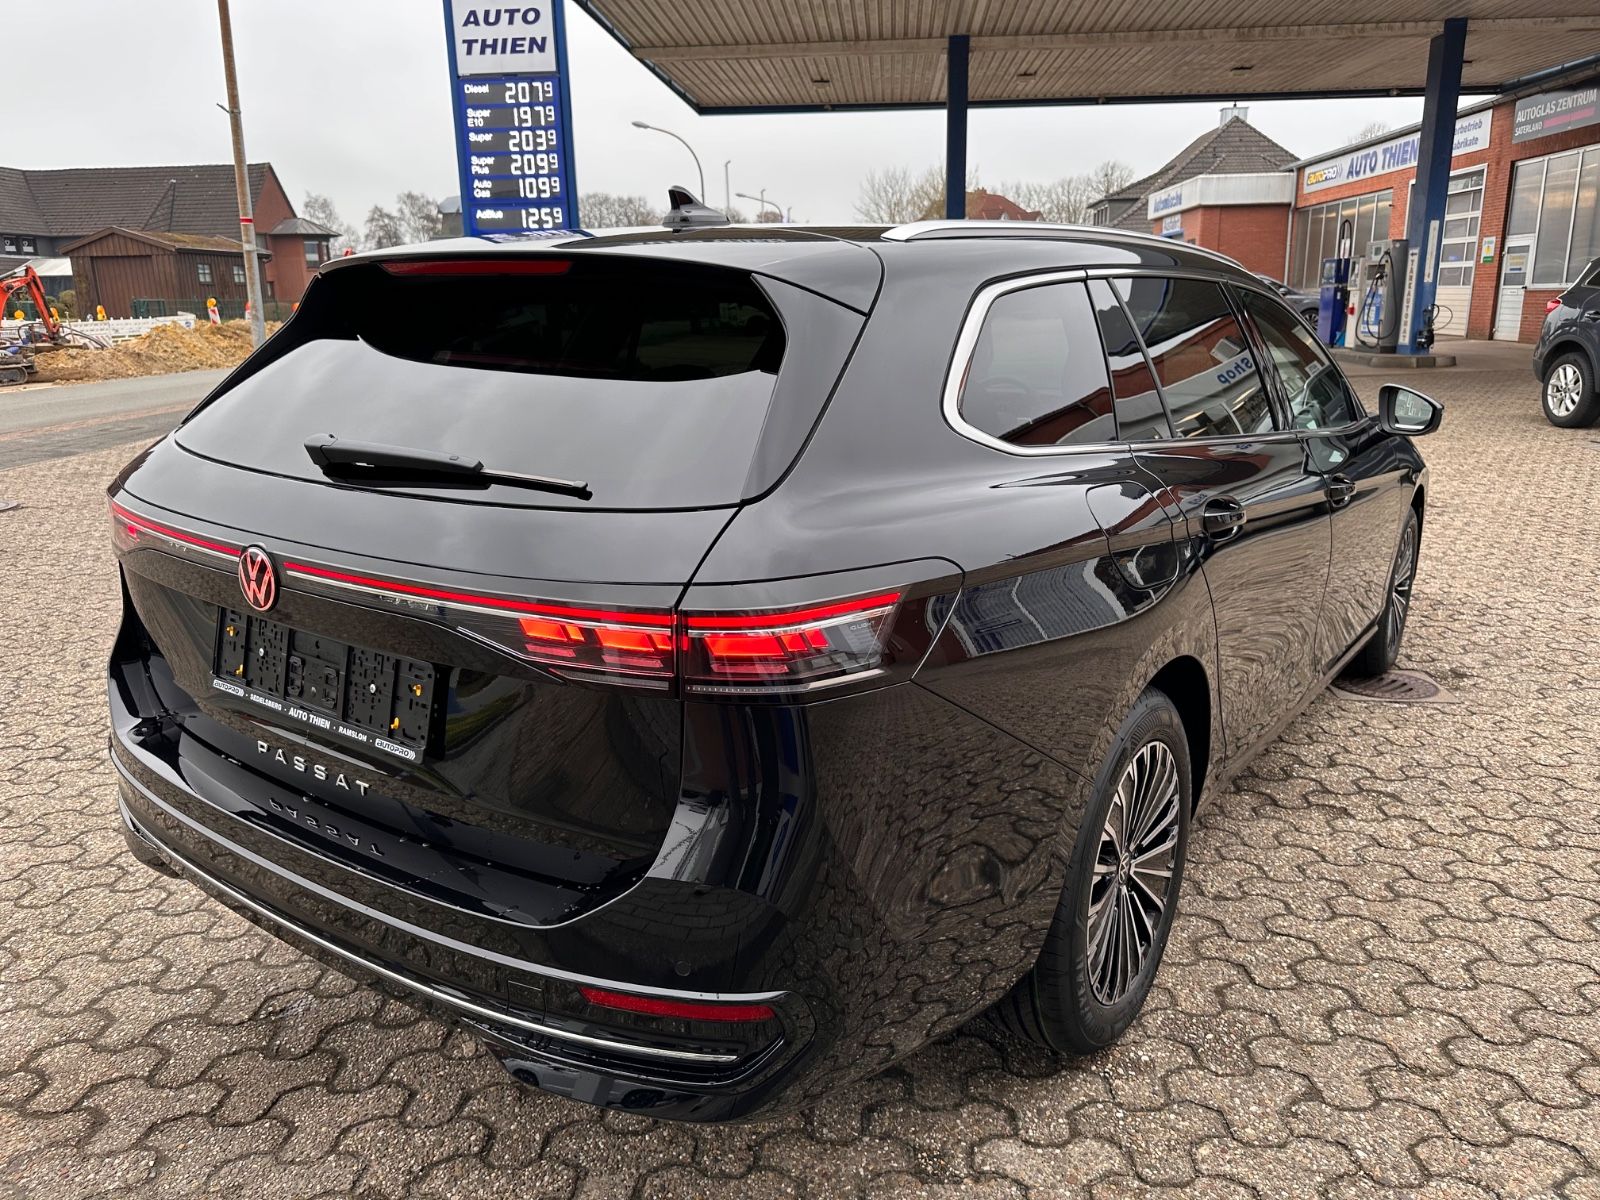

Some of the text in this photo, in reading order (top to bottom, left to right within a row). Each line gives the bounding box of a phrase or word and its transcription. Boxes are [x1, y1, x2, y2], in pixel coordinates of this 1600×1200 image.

[462, 7, 541, 27] AUTO
[462, 36, 547, 56] THIEN
[464, 83, 490, 94] Diesel
[1515, 88, 1597, 123] AUTOGLAS ZENTRUM
[467, 108, 491, 119] Super
[467, 118, 484, 127] E10
[1514, 121, 1543, 136] SATERLAND
[469, 132, 493, 143] Super
[471, 155, 495, 167] Super
[1346, 150, 1378, 180] AUTO
[1381, 137, 1420, 171] THIEN
[471, 165, 490, 175] Plus
[473, 179, 492, 189] Auto
[473, 188, 491, 198] Gas
[249, 693, 282, 711] SEDELSBERG
[288, 707, 308, 721] AUTO
[309, 714, 331, 730] THIEN
[338, 726, 367, 742] RAMSLOH
[257, 740, 370, 796] PASSAT
